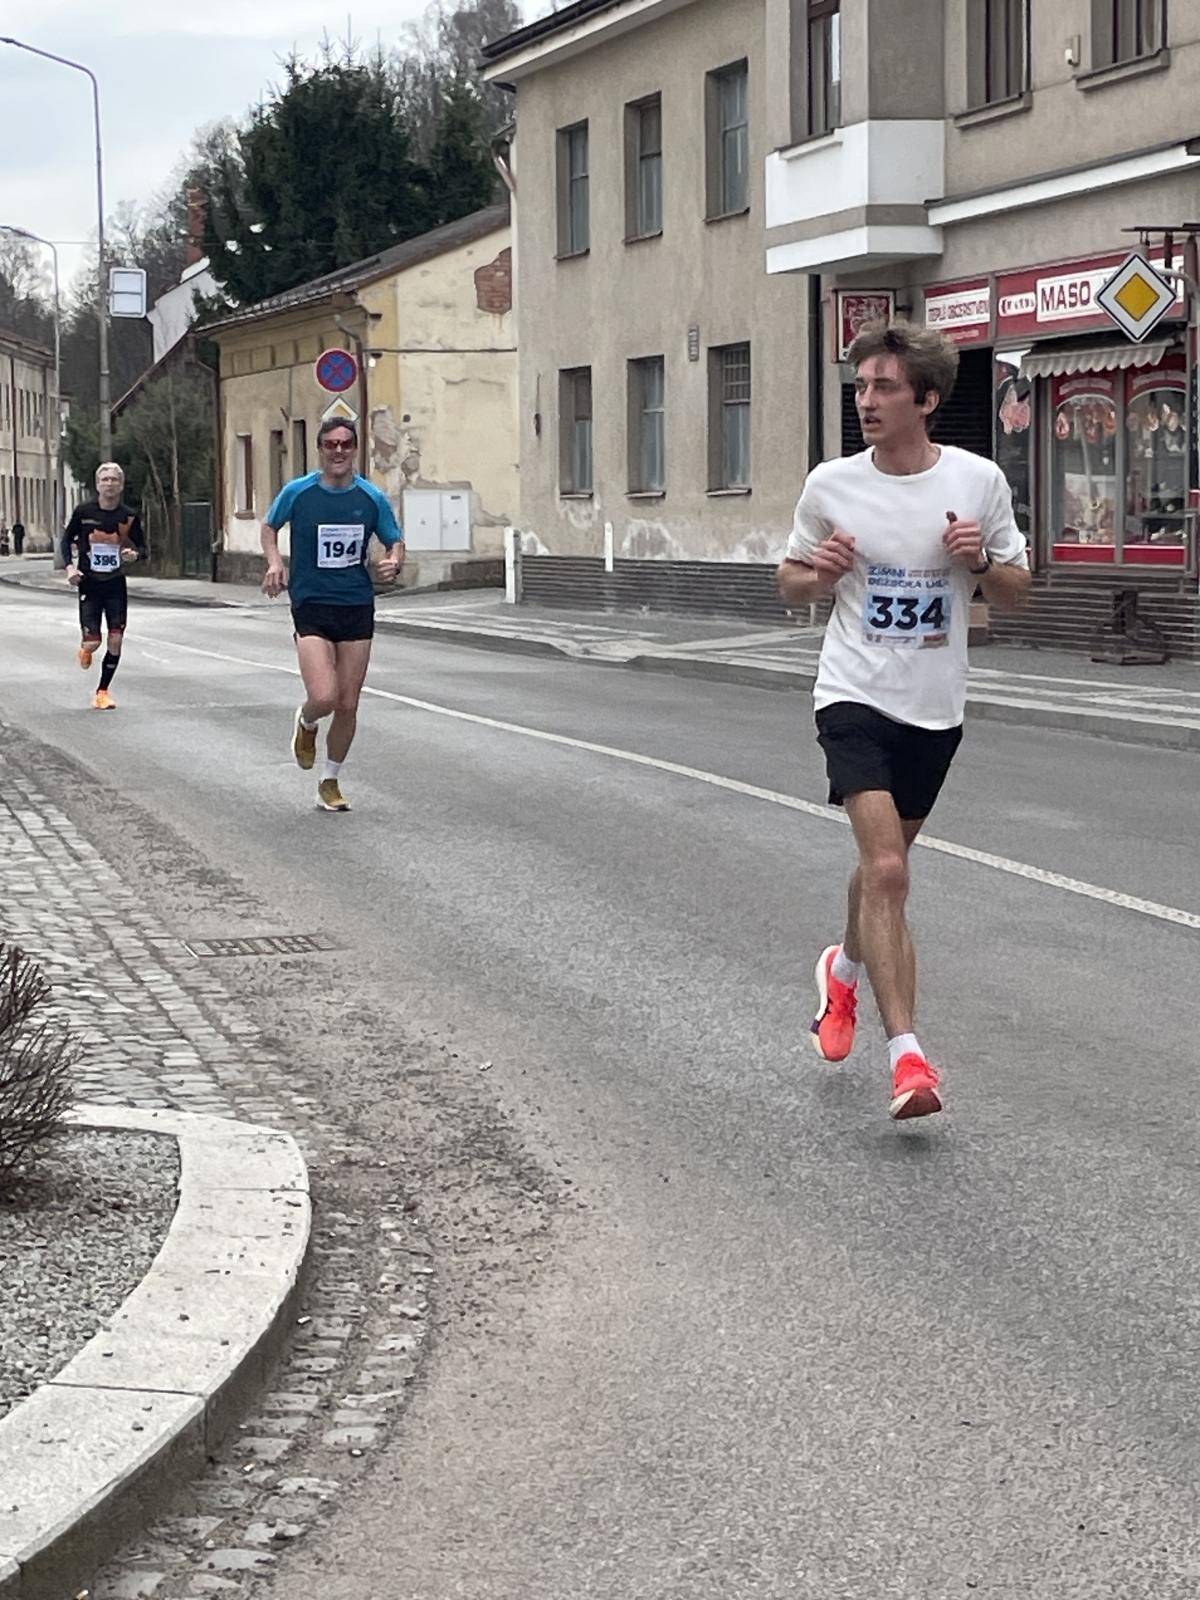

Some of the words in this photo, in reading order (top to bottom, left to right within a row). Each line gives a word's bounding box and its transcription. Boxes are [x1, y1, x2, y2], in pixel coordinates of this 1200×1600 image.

[1041, 280, 1091, 312] MASO
[93, 554, 117, 567] 396
[322, 540, 357, 558] 194
[869, 595, 944, 630] 334
